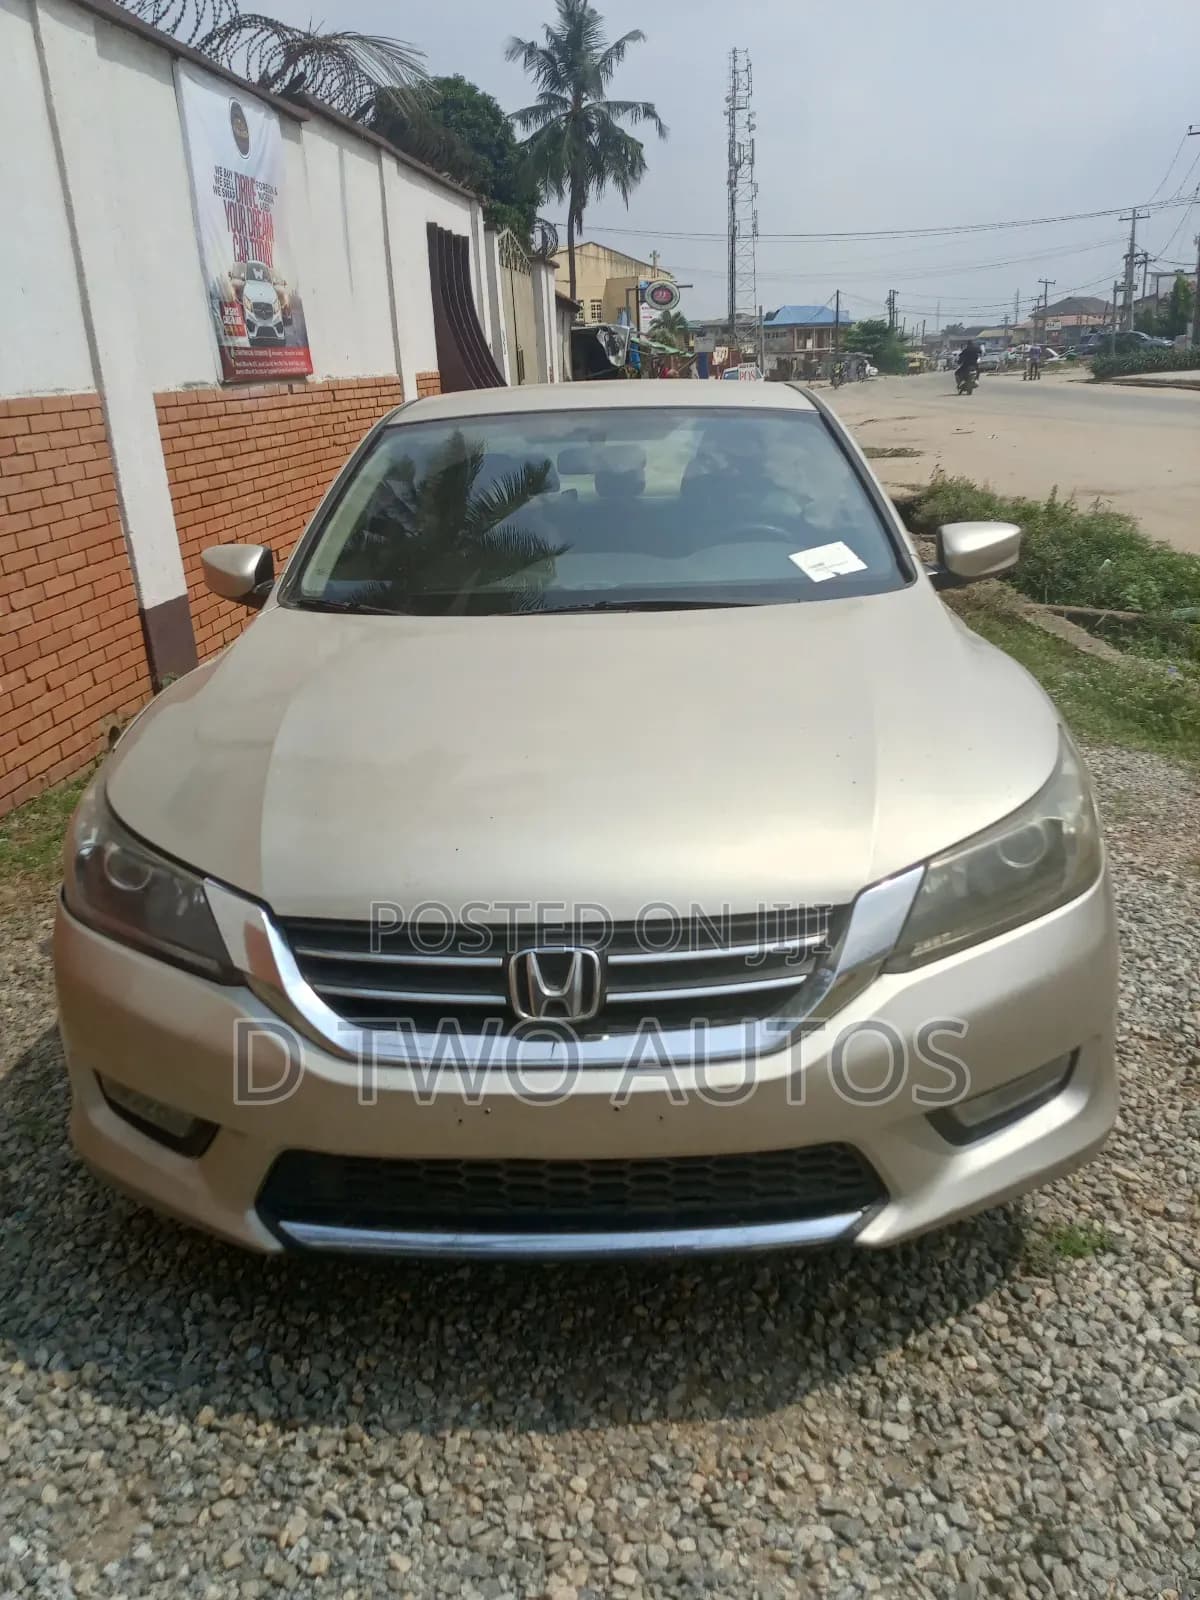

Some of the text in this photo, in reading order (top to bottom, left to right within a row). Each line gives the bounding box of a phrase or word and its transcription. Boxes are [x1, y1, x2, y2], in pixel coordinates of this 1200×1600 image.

[214, 165, 233, 180] WE BUY
[214, 174, 235, 190] WE SELL
[213, 184, 236, 200] WE SWAP
[234, 171, 258, 209] DRIVE
[223, 199, 273, 241] YOUR DREAM
[233, 232, 273, 268] CAR TODAY
